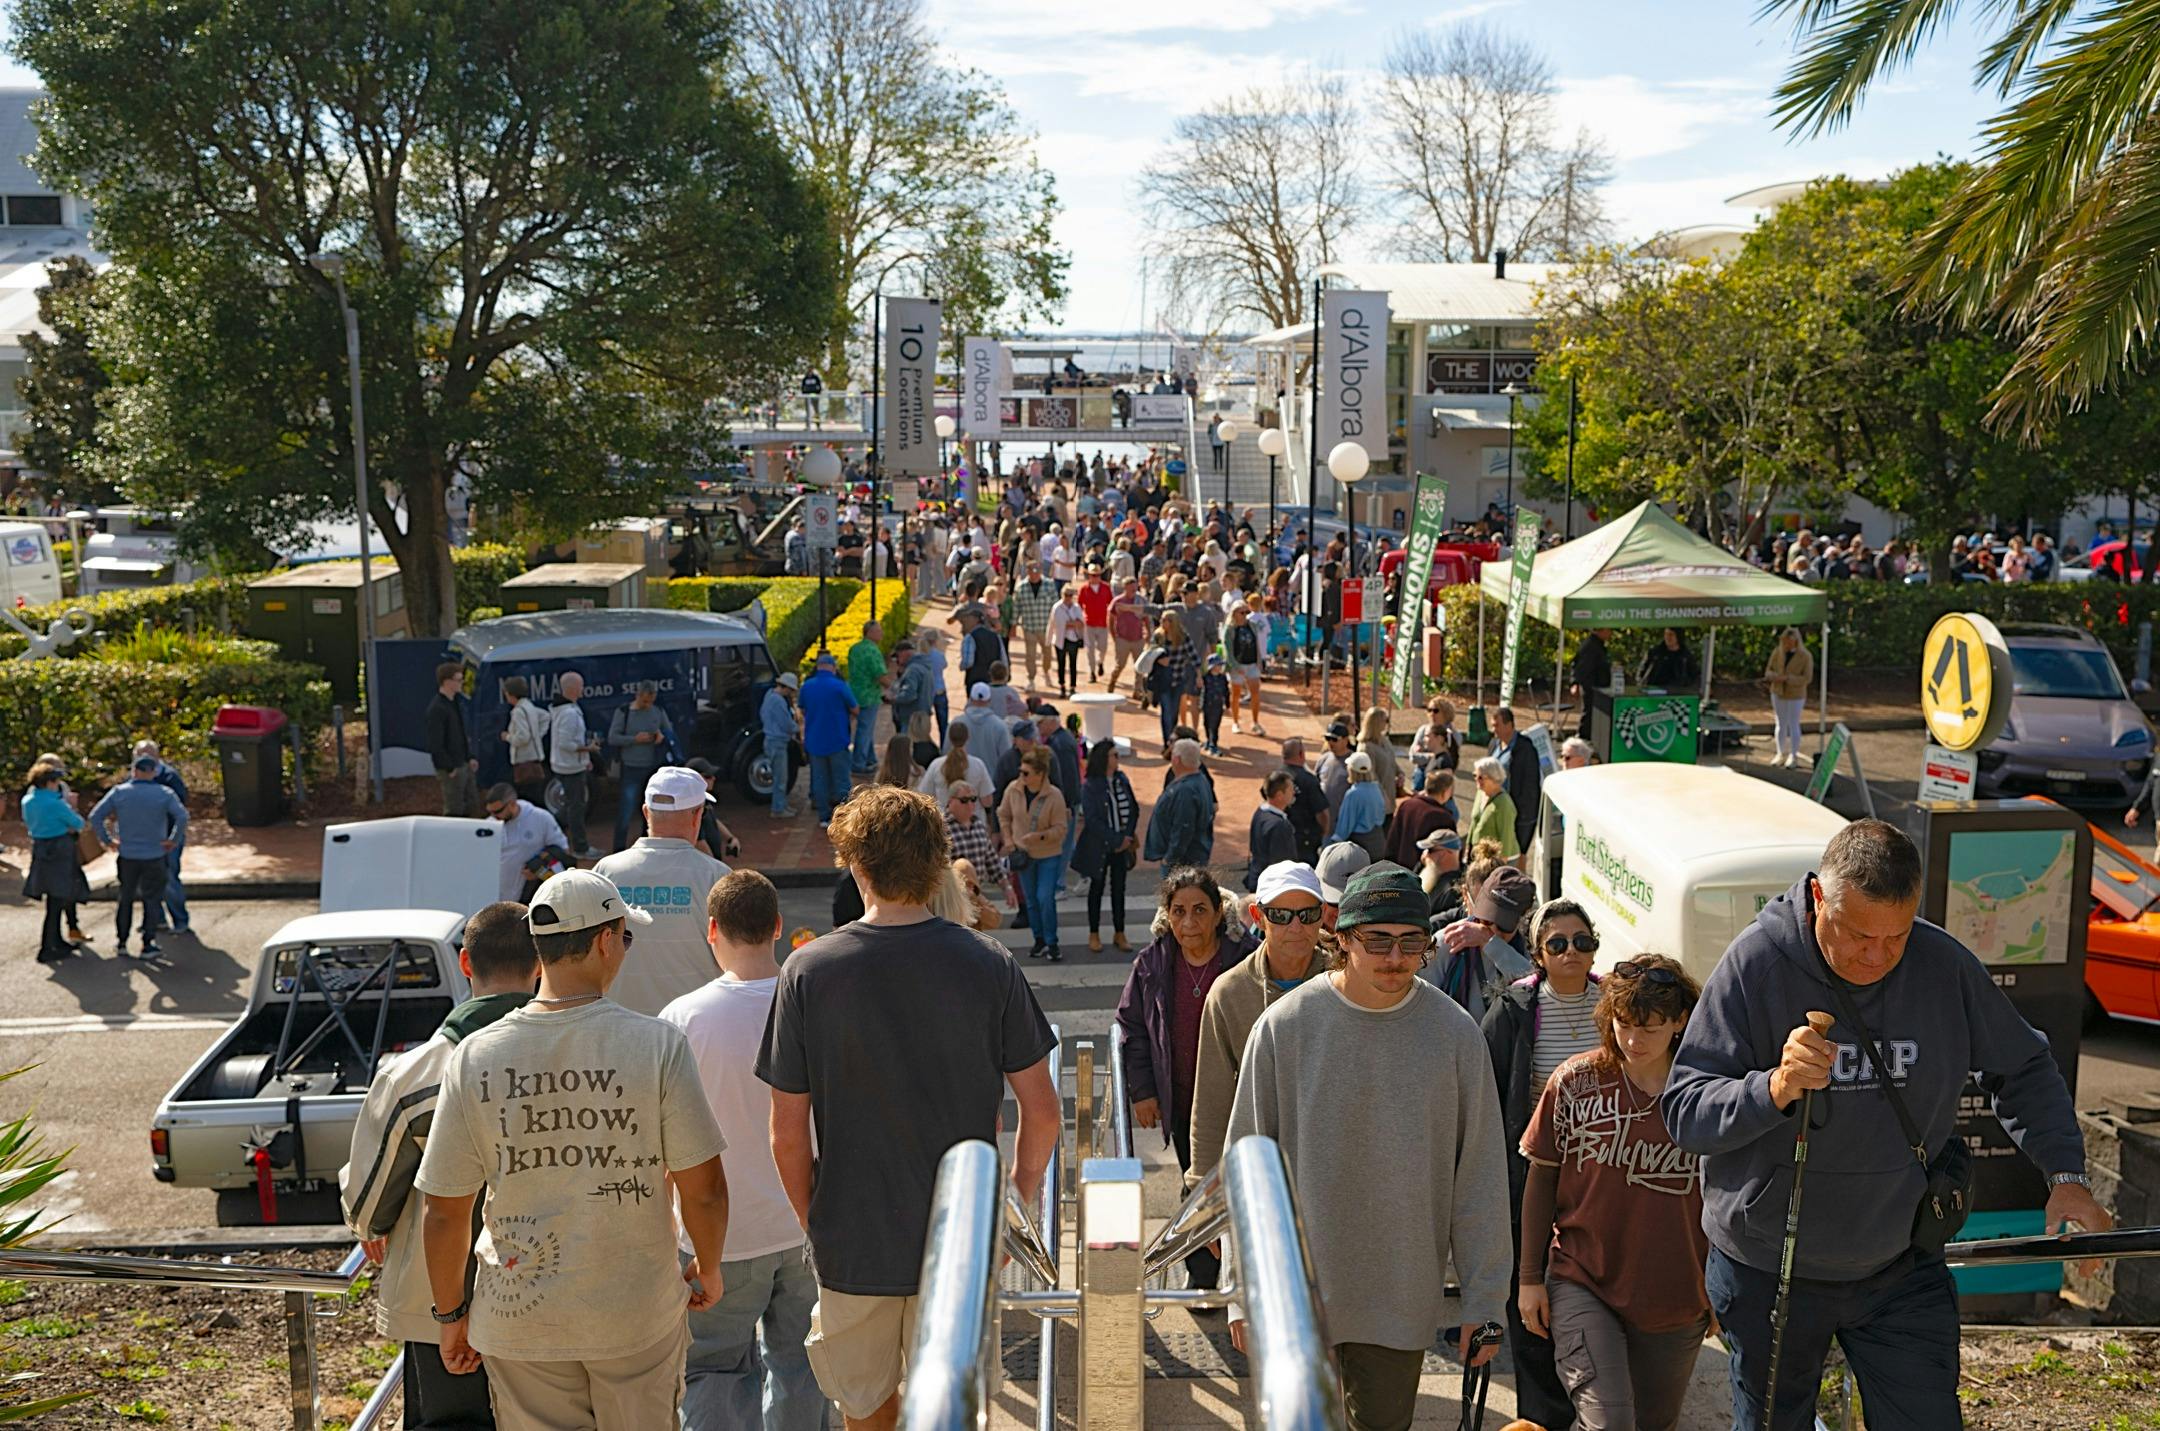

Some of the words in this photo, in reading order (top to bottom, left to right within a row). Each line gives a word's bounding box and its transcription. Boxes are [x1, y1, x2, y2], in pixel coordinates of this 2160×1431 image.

[900, 323, 924, 362] 10
[974, 348, 991, 422] d'Albora
[1340, 308, 1370, 438] d'Albora
[1444, 362, 1480, 379] THE
[1495, 362, 1538, 379] WOO
[898, 367, 912, 451] Locations
[912, 368, 924, 446] Premium
[1033, 407, 1072, 419] WOOD
[1392, 531, 1431, 698] SHANNONS
[1598, 608, 1626, 620] JOIN
[1629, 608, 1651, 620] THE
[1654, 606, 1721, 619] SHANNONS
[1723, 605, 1755, 618] CLUB
[1757, 604, 1795, 616] TODAY
[577, 683, 614, 698] OAD
[621, 677, 674, 695] SEICE
[1576, 821, 1597, 868] Port
[1599, 839, 1655, 912] Stephens
[479, 1070, 491, 1103] i
[504, 1067, 624, 1099] know,
[499, 1107, 510, 1138] i
[521, 1103, 639, 1136] know,
